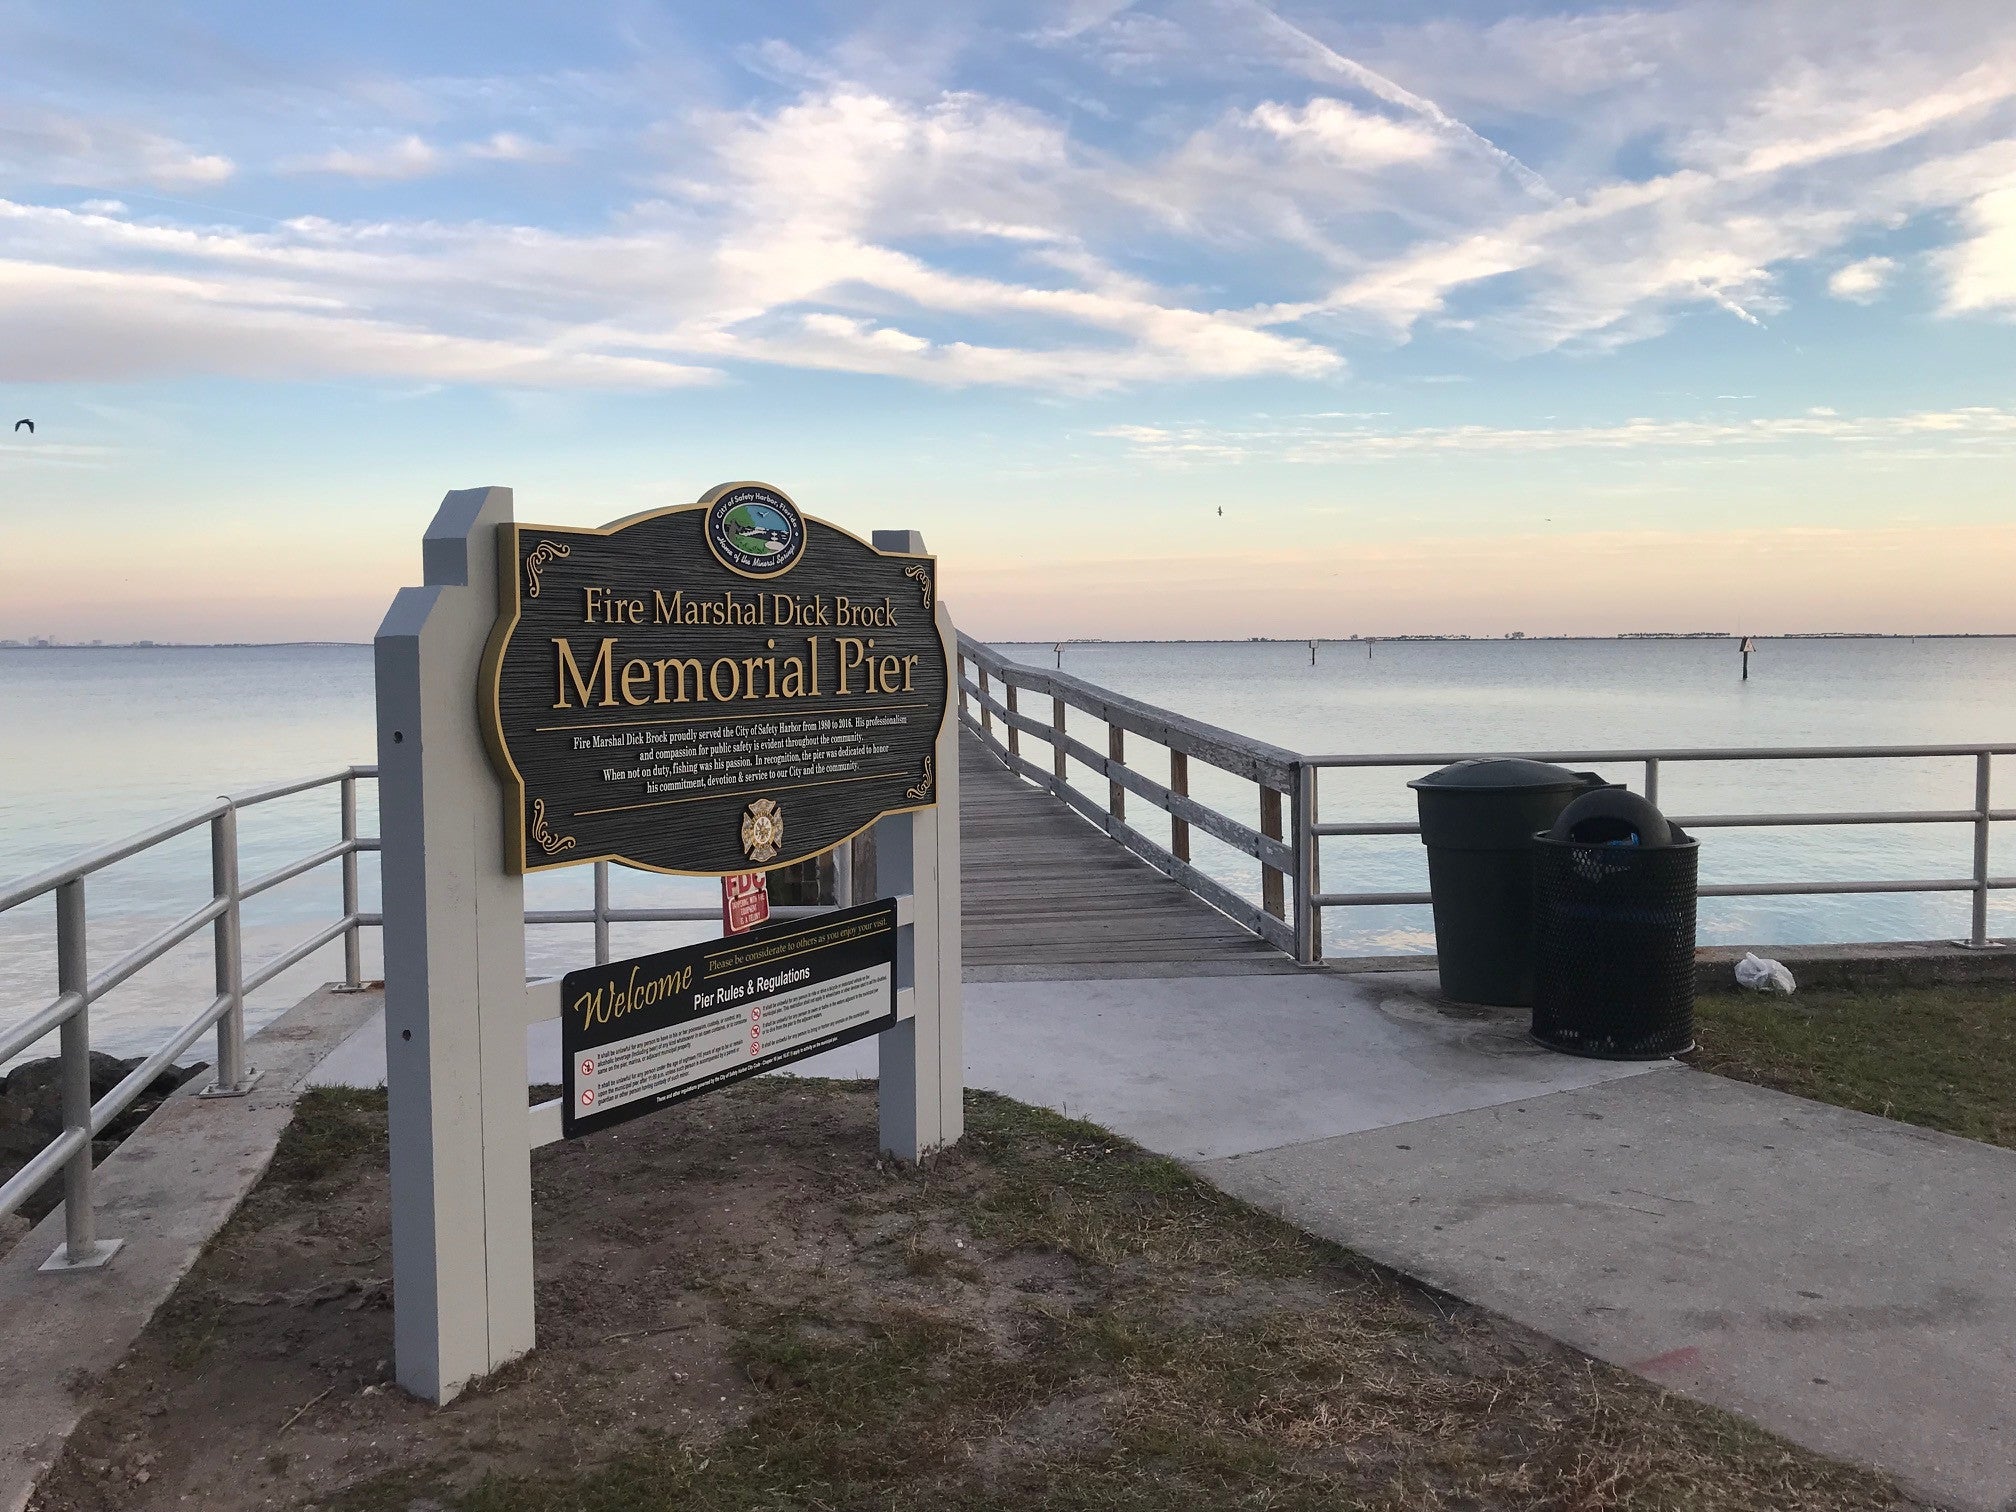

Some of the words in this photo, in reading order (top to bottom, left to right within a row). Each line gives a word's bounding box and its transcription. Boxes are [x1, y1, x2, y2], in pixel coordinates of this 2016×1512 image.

[717, 505, 729, 519] City
[728, 498, 735, 506] of
[735, 493, 754, 502] Safety
[755, 493, 779, 507] Harbor,
[779, 503, 797, 528] Florida
[717, 536, 733, 556] Home
[734, 552, 741, 562] of
[741, 556, 750, 565] the
[752, 556, 775, 567] Mineral
[777, 544, 795, 564] Springs
[583, 587, 645, 624] Fire
[653, 590, 766, 626] Marshal
[772, 594, 829, 627] Dick
[834, 596, 898, 627] Brock
[551, 636, 822, 708] Memorial
[834, 637, 919, 695] Pier
[574, 737, 591, 749] Fire
[593, 733, 625, 748] Marshal
[626, 733, 644, 745] Dick
[646, 731, 668, 744] Brock
[669, 729, 697, 744] proudly
[699, 727, 721, 739] served
[723, 726, 734, 738] the
[735, 726, 749, 738] City
[750, 724, 758, 735] of
[758, 723, 778, 736] Safety
[779, 722, 802, 734] Harbor
[802, 721, 817, 731] from
[832, 721, 838, 729] to
[856, 717, 865, 727] His
[866, 715, 907, 728] professionalism
[640, 748, 654, 761] and
[656, 746, 697, 760] compassion
[698, 744, 708, 755] for
[710, 742, 732, 755] public
[733, 740, 752, 753] safety
[754, 740, 759, 750] is
[761, 738, 784, 750] evident
[786, 736, 820, 750] throughout
[821, 734, 830, 744] the
[831, 733, 864, 745] community.
[603, 768, 626, 781] When
[628, 767, 640, 779] not
[642, 769, 650, 778] on
[653, 764, 672, 777] duty,
[673, 762, 698, 774] fishing
[700, 762, 713, 771] was
[714, 759, 725, 770] his
[726, 757, 752, 771] passion.
[755, 754, 763, 765] In
[764, 752, 801, 767] recognition,
[802, 751, 811, 761] the
[813, 750, 825, 762] pier
[826, 750, 837, 758] was
[838, 745, 865, 757] dedicated
[866, 746, 872, 755] to
[873, 744, 889, 754] honor
[647, 781, 658, 794] his
[660, 778, 706, 792] commitment,
[707, 774, 737, 786] devotion
[738, 771, 744, 783] &
[745, 770, 768, 782] service
[769, 770, 776, 779] to
[777, 769, 788, 779] our
[789, 766, 802, 778] City
[803, 764, 815, 775] and
[816, 763, 825, 773] the
[826, 760, 859, 773] community.
[709, 957, 733, 971] Please
[735, 953, 744, 965] be
[745, 943, 787, 961] considerate
[788, 942, 795, 950] to
[796, 937, 817, 948] others
[826, 931, 839, 943] you
[840, 926, 857, 940] enjoy
[858, 922, 873, 936] your
[874, 918, 887, 930] visit.
[574, 965, 692, 1031] Welcome
[694, 993, 714, 1010] Pier
[717, 984, 744, 1004] Rules
[747, 979, 754, 994] &
[757, 965, 810, 995] Regulations
